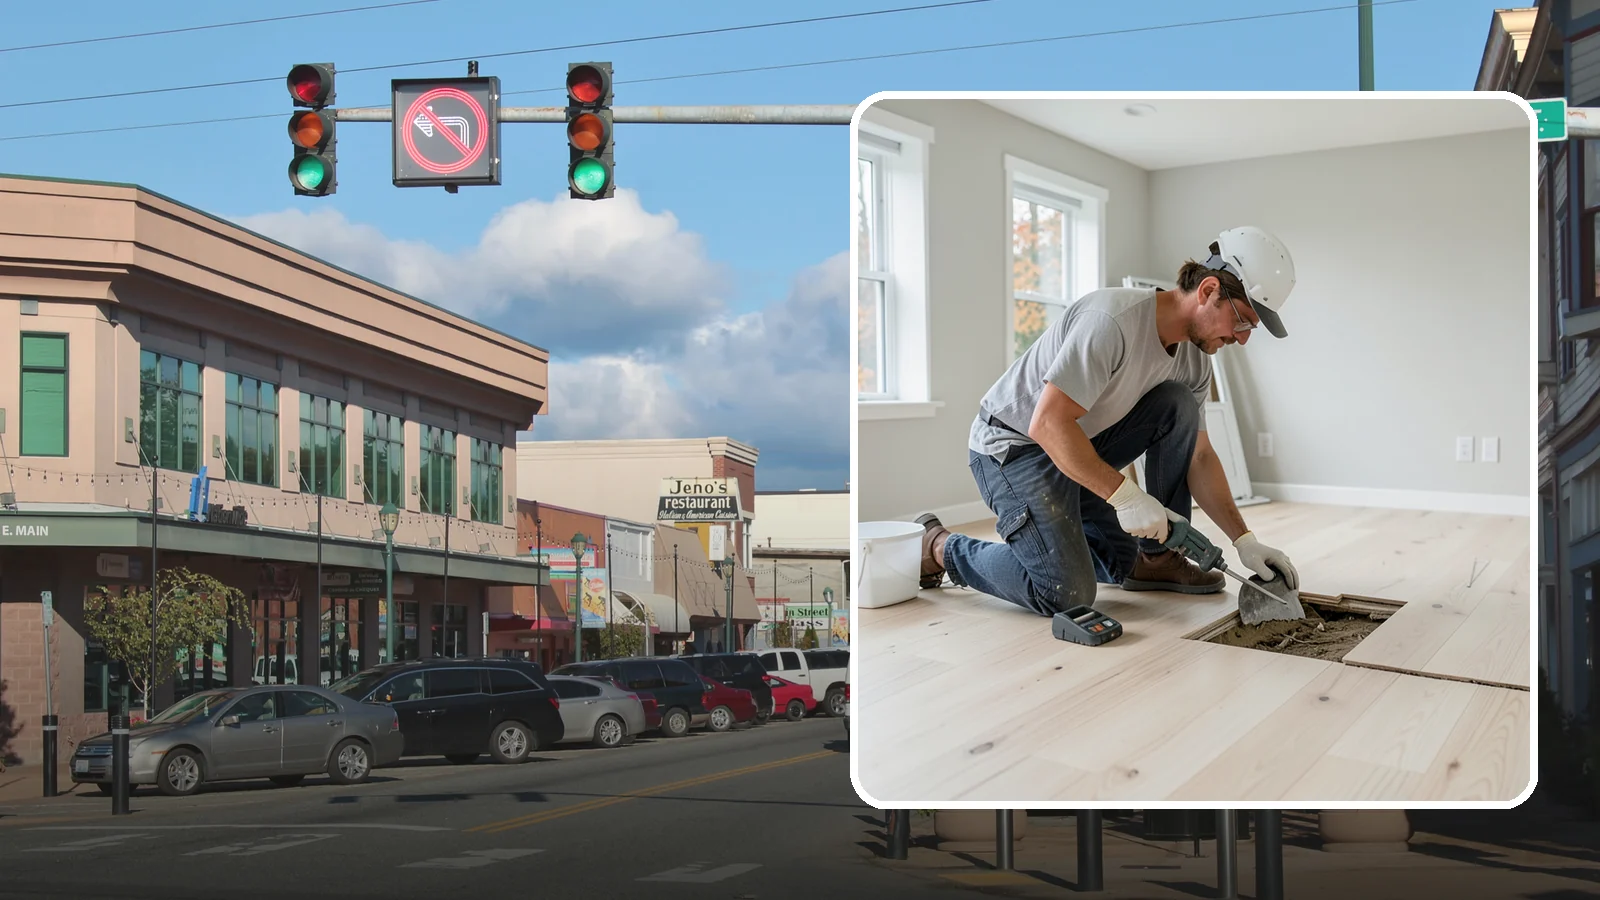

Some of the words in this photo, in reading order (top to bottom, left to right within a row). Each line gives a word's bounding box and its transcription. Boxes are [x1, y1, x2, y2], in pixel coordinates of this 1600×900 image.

[670, 480, 727, 494] Jeno's
[665, 496, 730, 509] restaurant
[686, 510, 714, 519] American
[715, 510, 737, 519] Cuisine
[2, 525, 13, 536] E.
[15, 525, 49, 536] MAIN
[797, 608, 828, 616] Street
